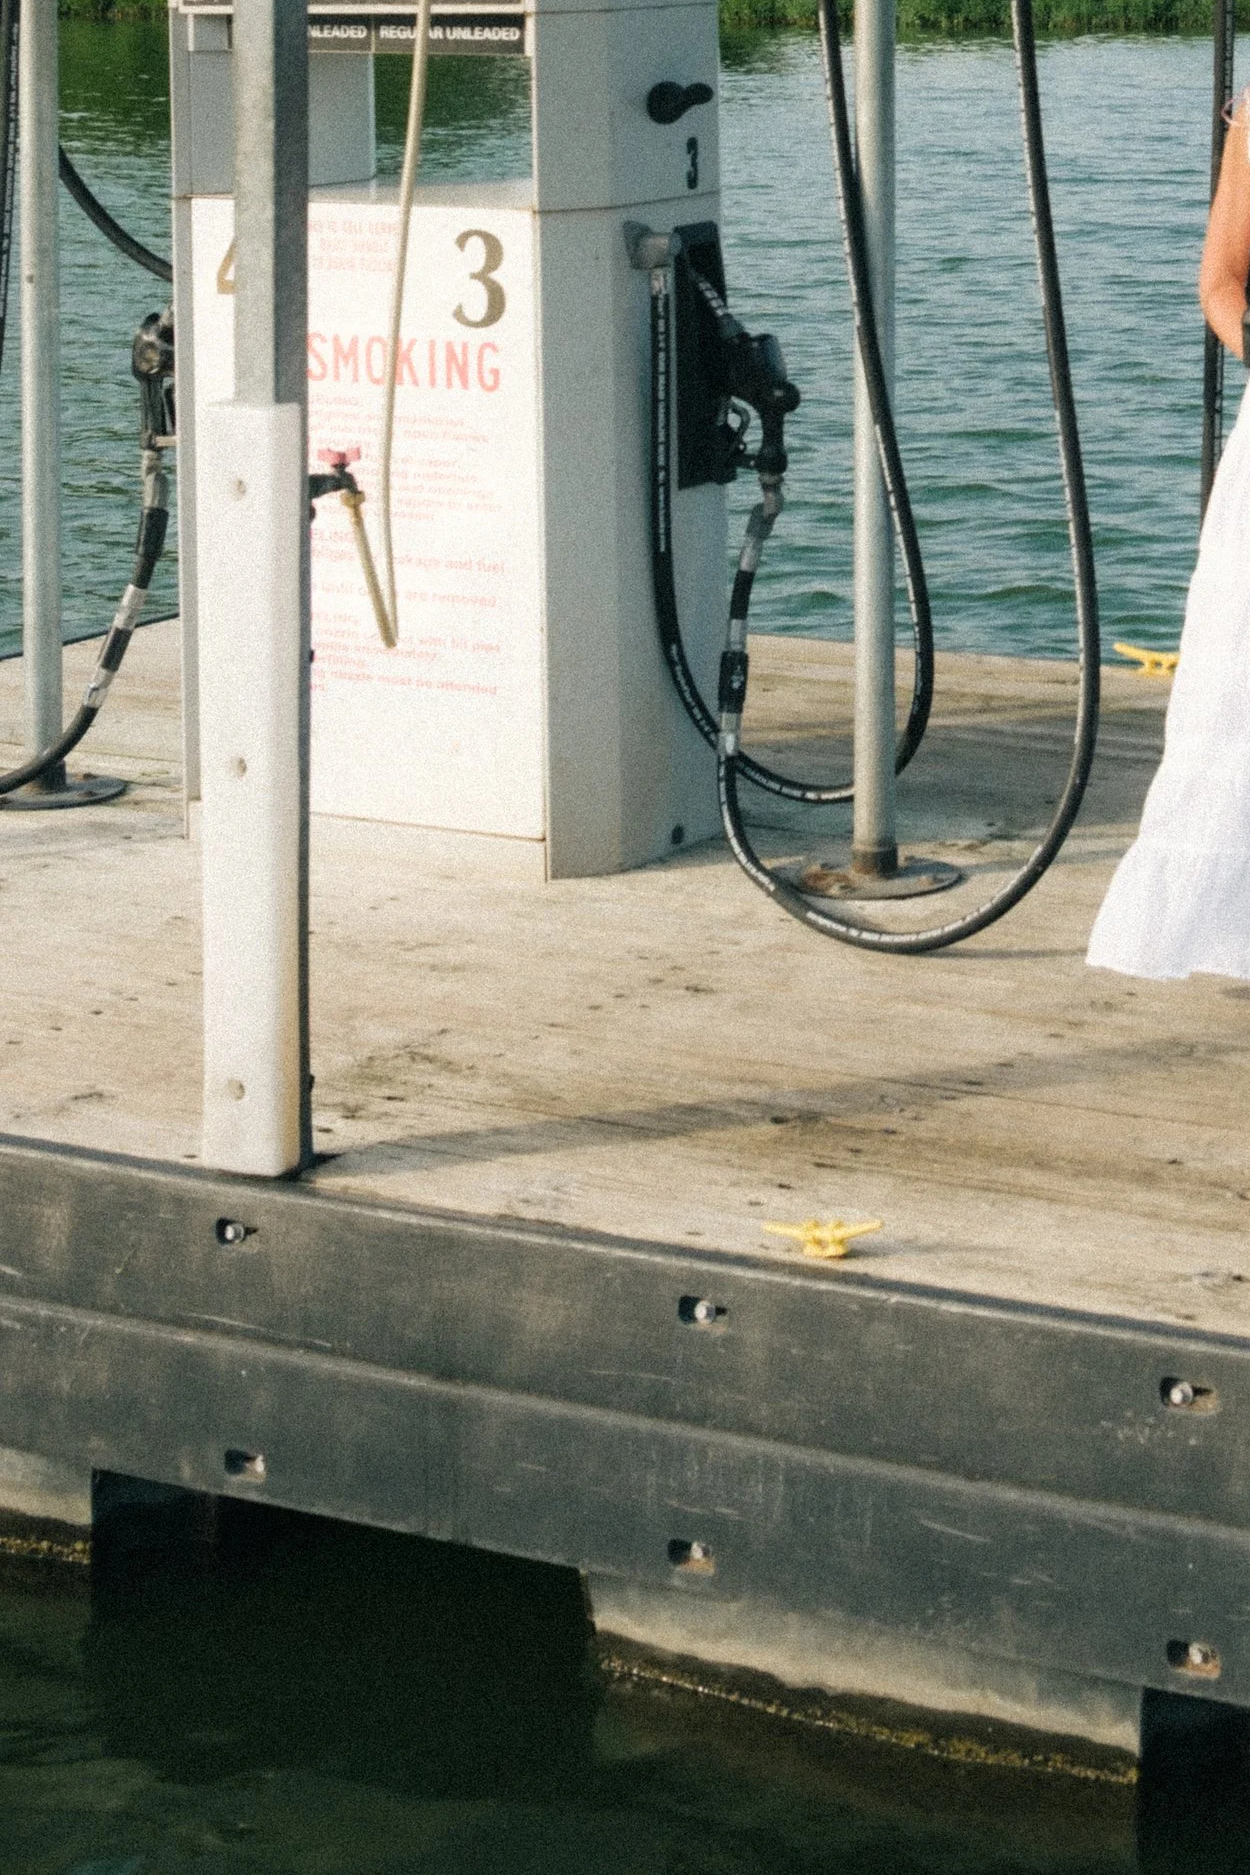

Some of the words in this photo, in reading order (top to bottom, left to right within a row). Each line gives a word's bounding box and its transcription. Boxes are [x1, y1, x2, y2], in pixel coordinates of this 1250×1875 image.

[308, 26, 367, 39] NLEADED
[379, 26, 444, 40] REGUAR
[445, 27, 520, 41] UNLEADED
[686, 136, 699, 190] 3
[452, 228, 506, 329] 3
[307, 332, 500, 393] SMOKING
